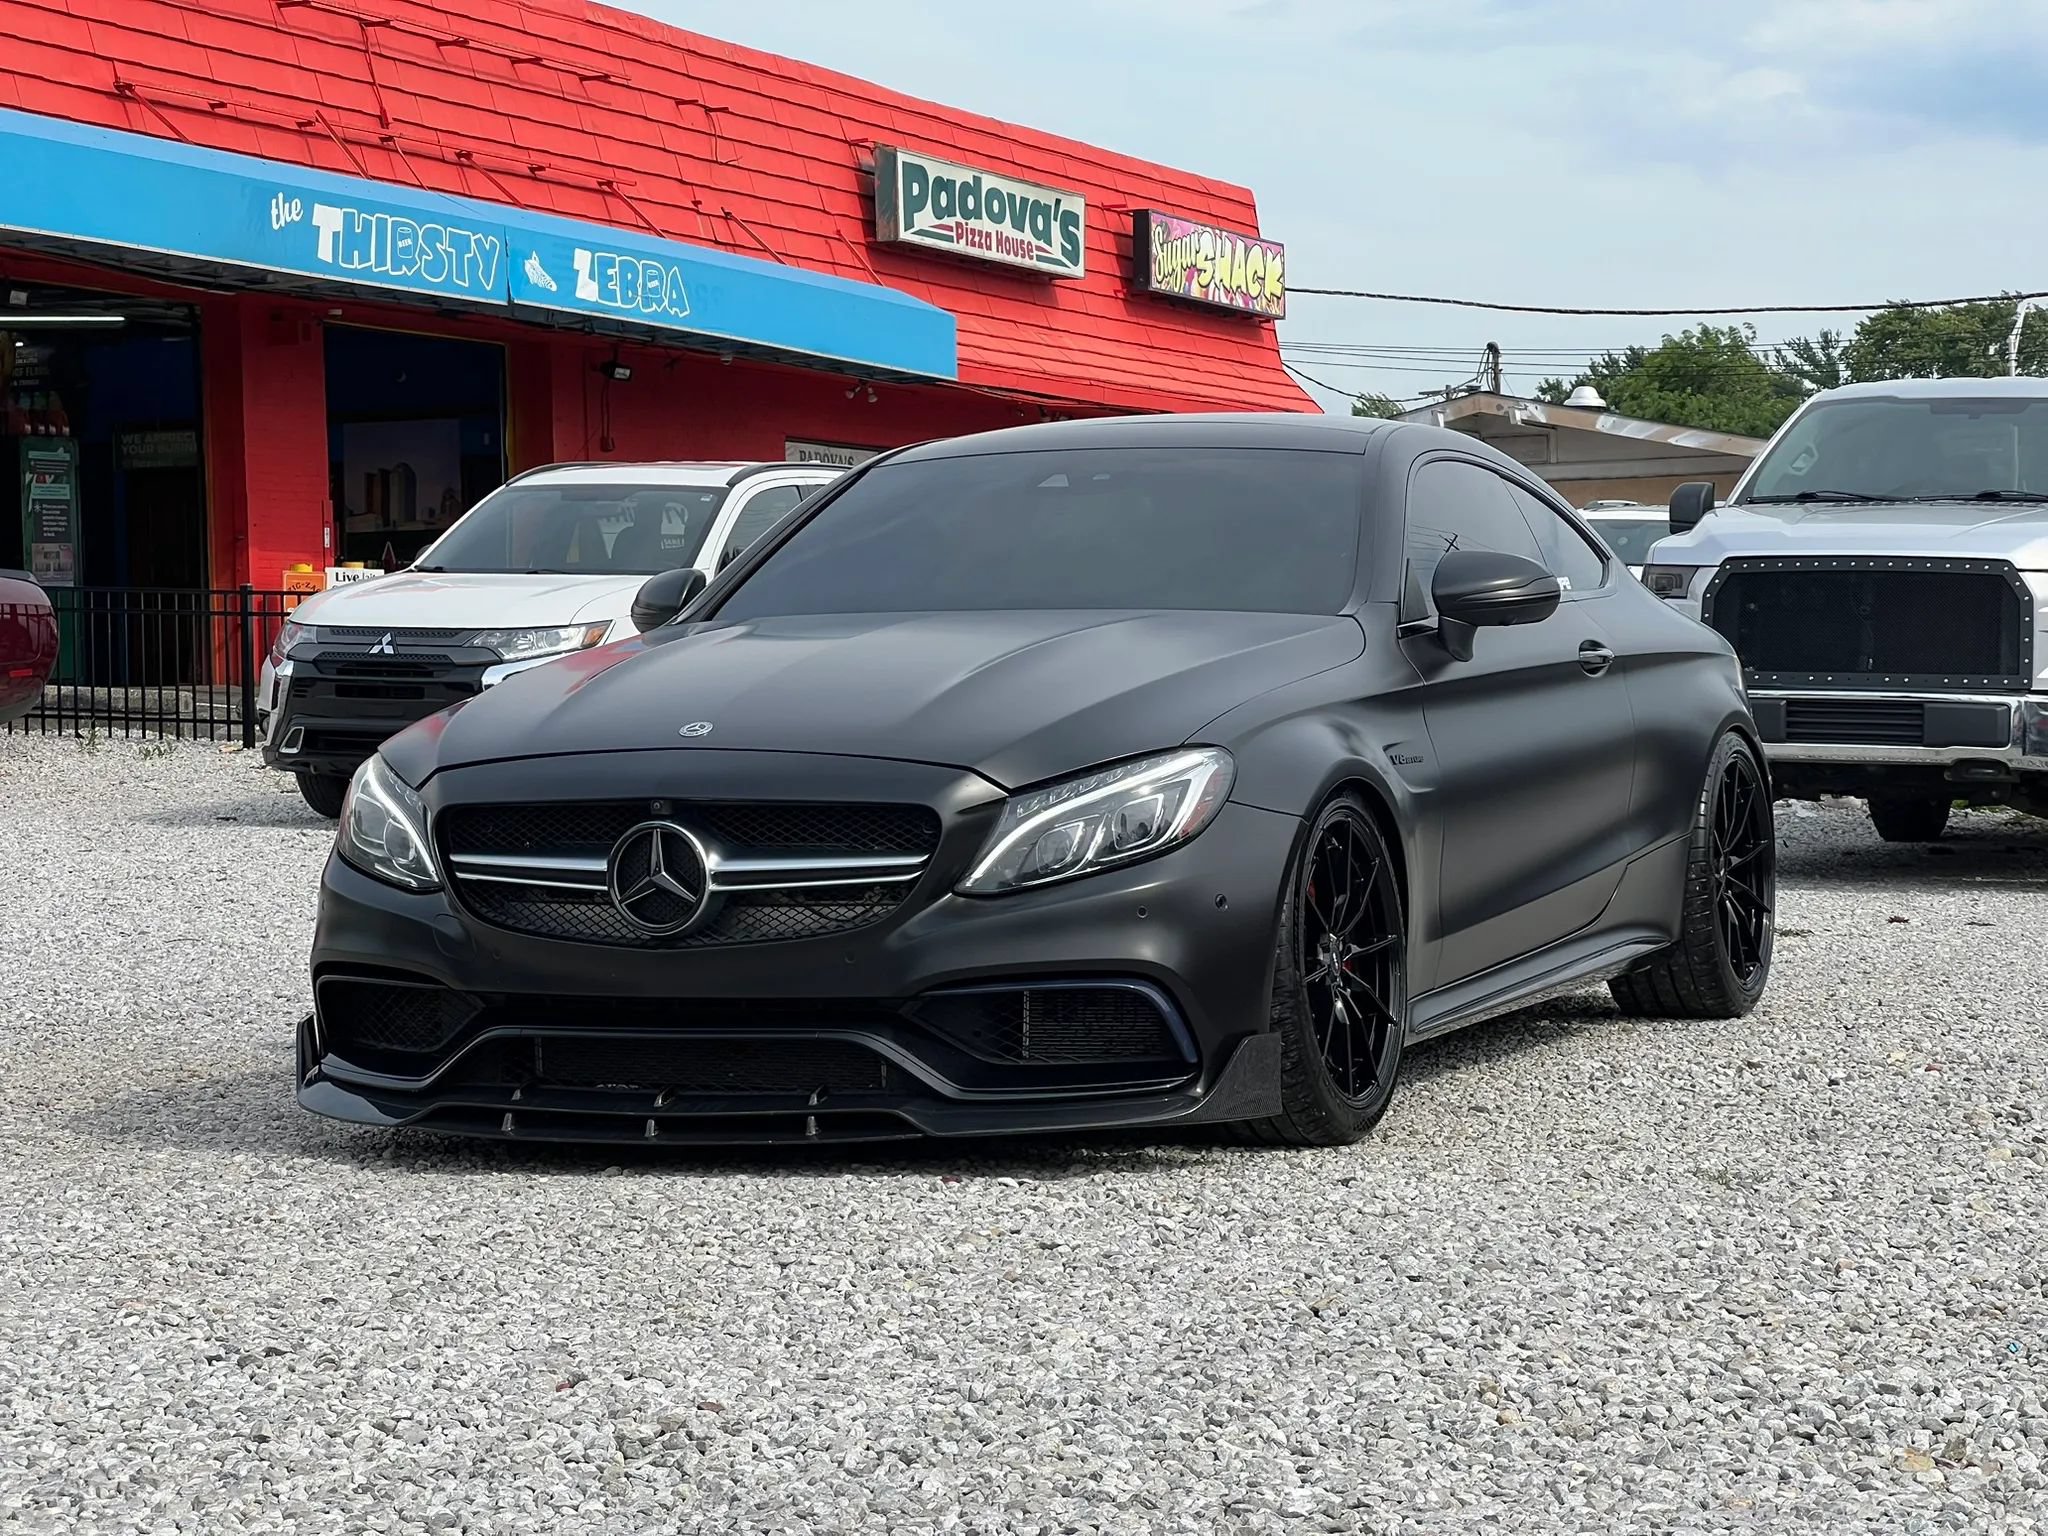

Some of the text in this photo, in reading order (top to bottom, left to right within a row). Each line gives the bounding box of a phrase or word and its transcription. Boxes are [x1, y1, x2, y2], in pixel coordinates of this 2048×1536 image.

[902, 160, 1080, 268] Padova's
[955, 221, 1034, 261] Pizza House
[271, 191, 690, 318] the THIRSTY ZEBRA
[1154, 224, 1284, 302] Sugar SHACK
[335, 571, 360, 582] Live
